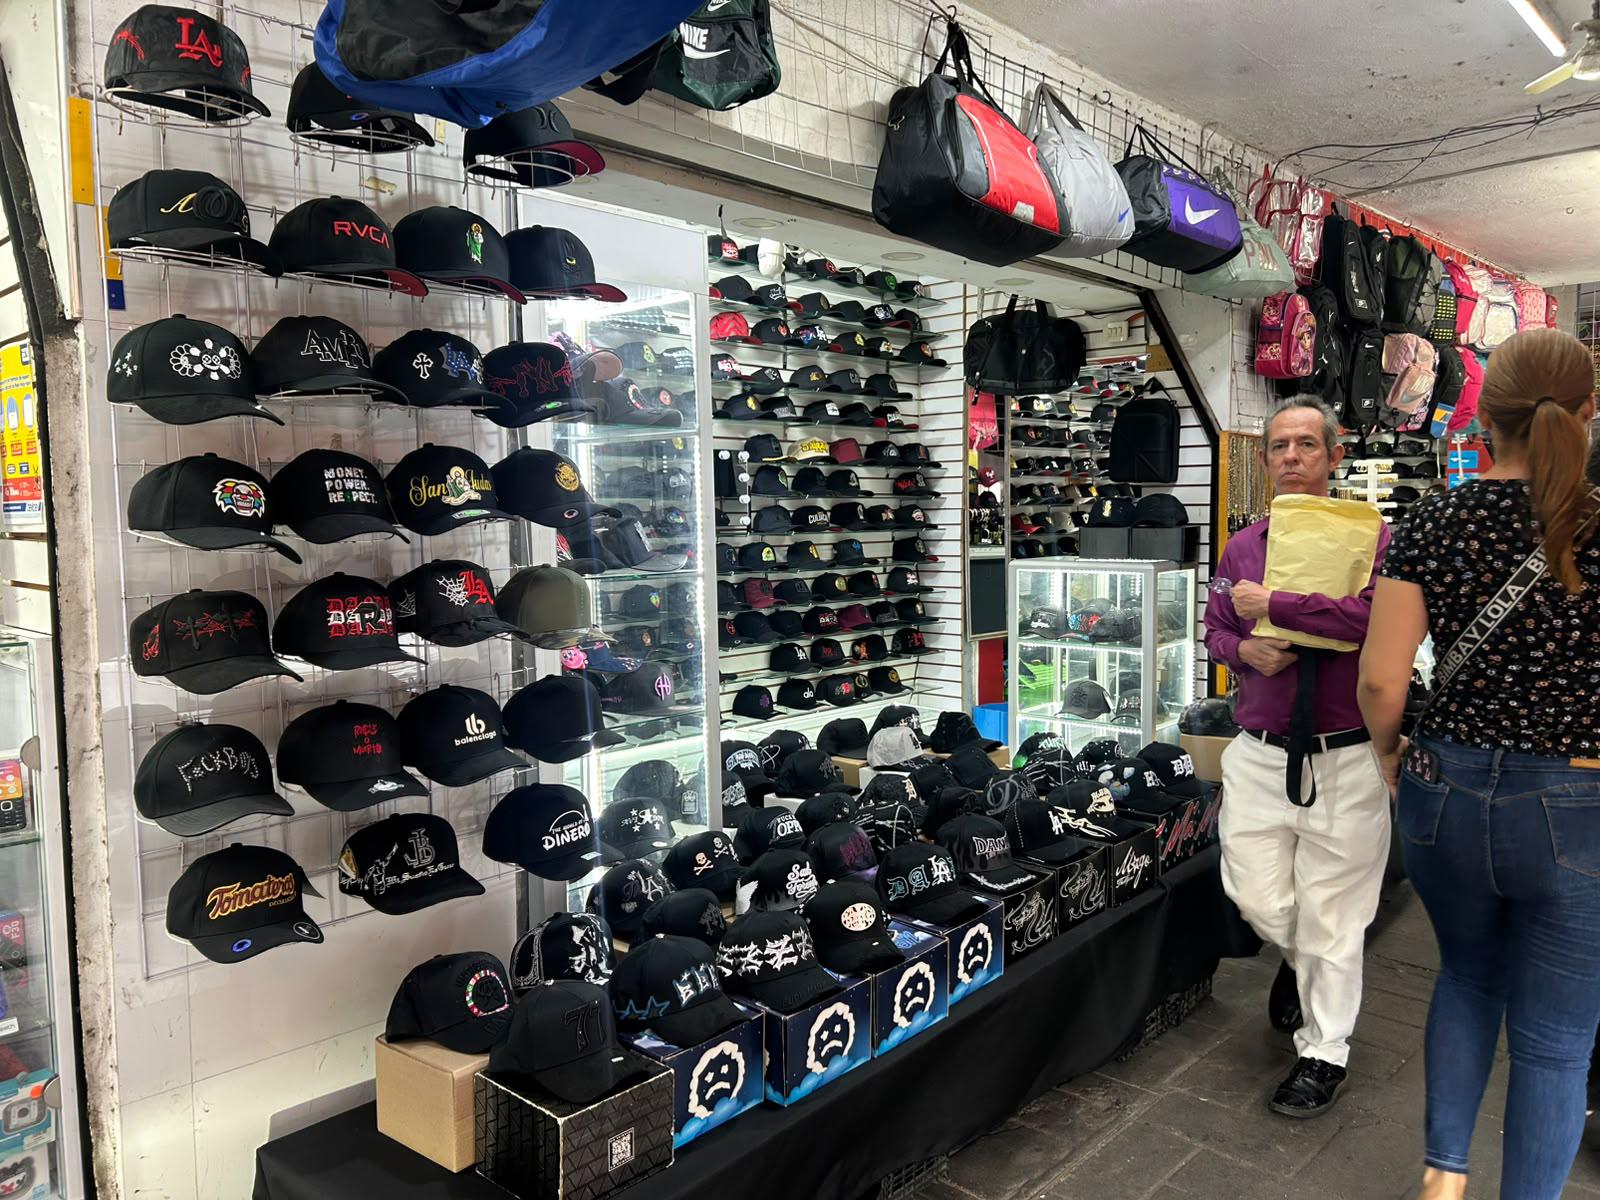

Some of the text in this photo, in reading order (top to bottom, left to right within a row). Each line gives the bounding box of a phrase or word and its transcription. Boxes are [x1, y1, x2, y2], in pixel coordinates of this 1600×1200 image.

[176, 17, 224, 67] LA
[680, 22, 708, 50] NIKE
[333, 220, 390, 248] RVCA
[541, 821, 591, 851] DINERO
[205, 873, 296, 920] Tomateros
